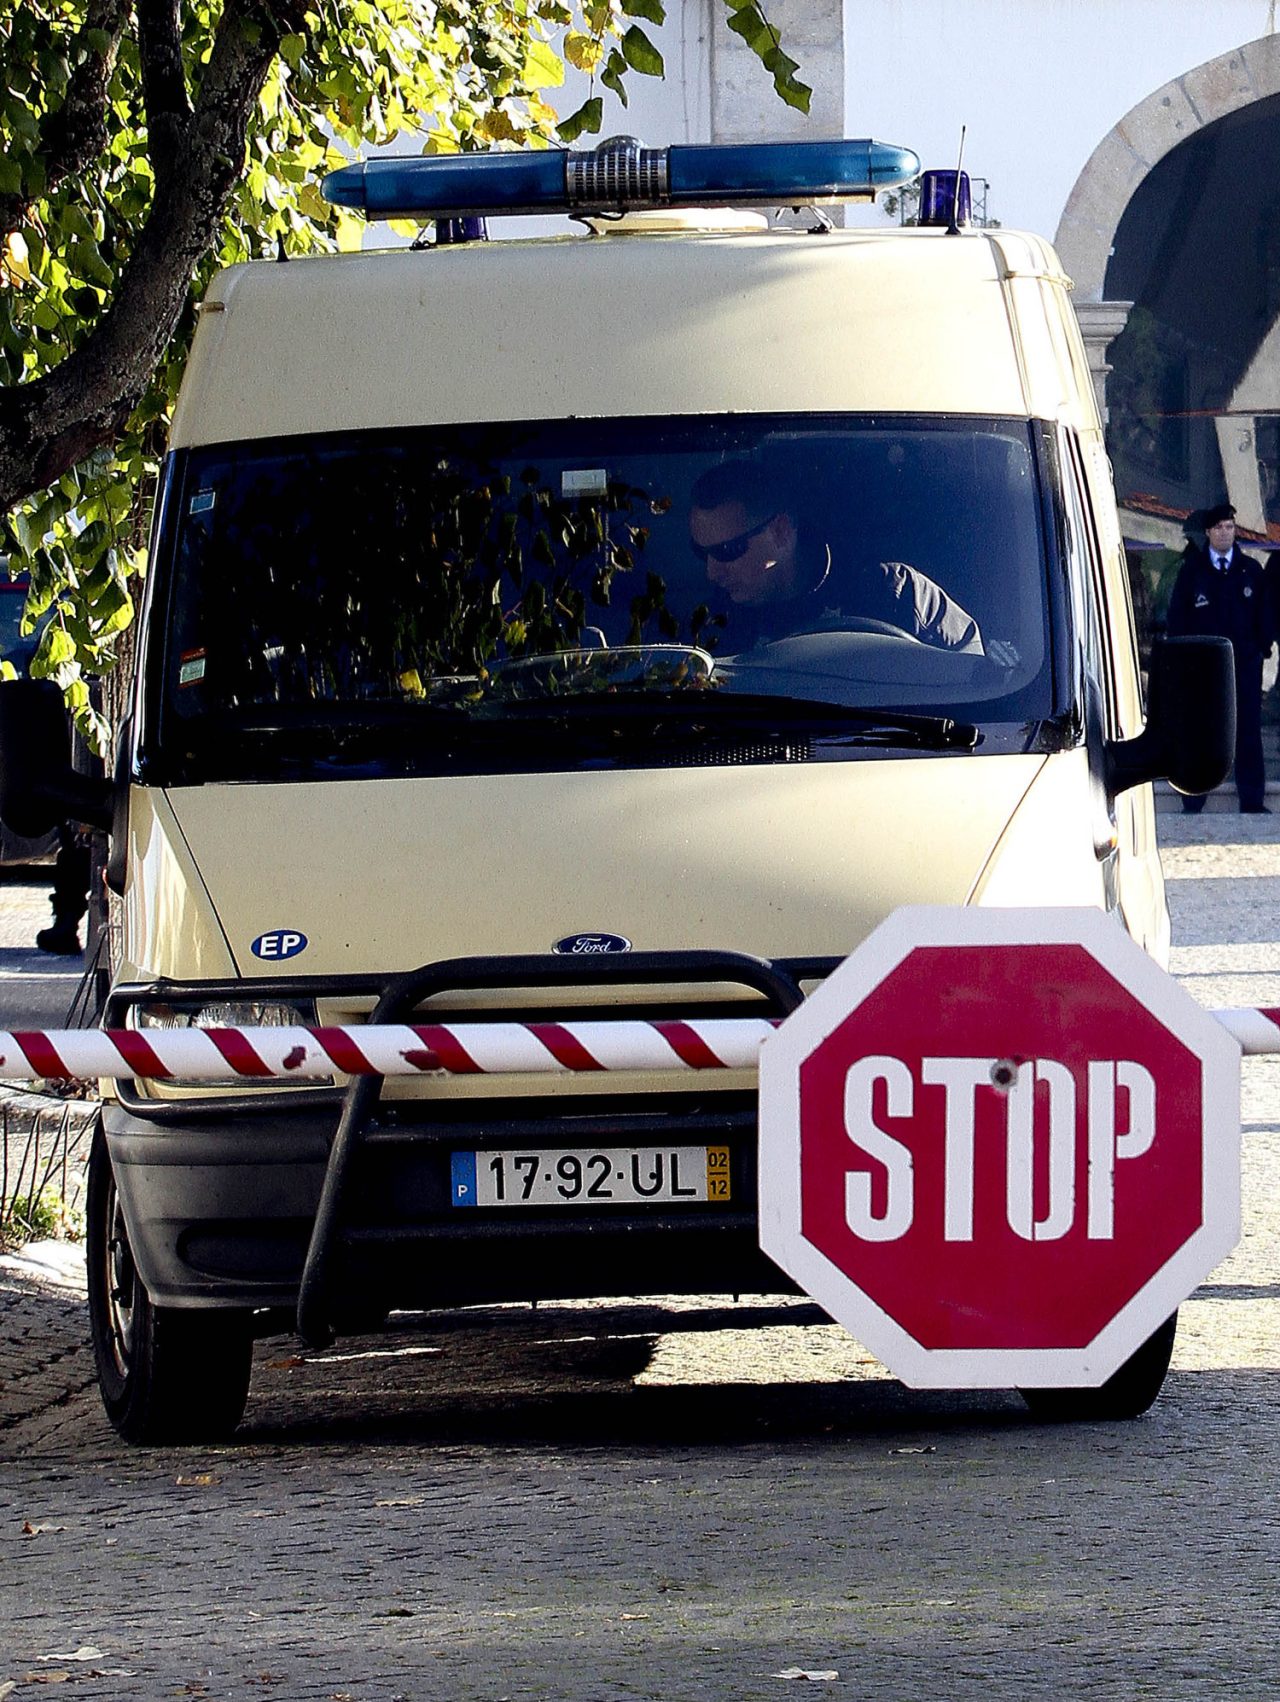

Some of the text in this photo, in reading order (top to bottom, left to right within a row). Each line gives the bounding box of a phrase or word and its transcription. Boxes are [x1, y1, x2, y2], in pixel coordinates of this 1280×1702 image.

[260, 934, 301, 956] EP
[572, 937, 611, 953] Ford
[844, 1055, 1156, 1243] STOP
[708, 1152, 728, 1167] 02
[457, 1185, 469, 1197] P
[709, 1179, 728, 1195] 12
